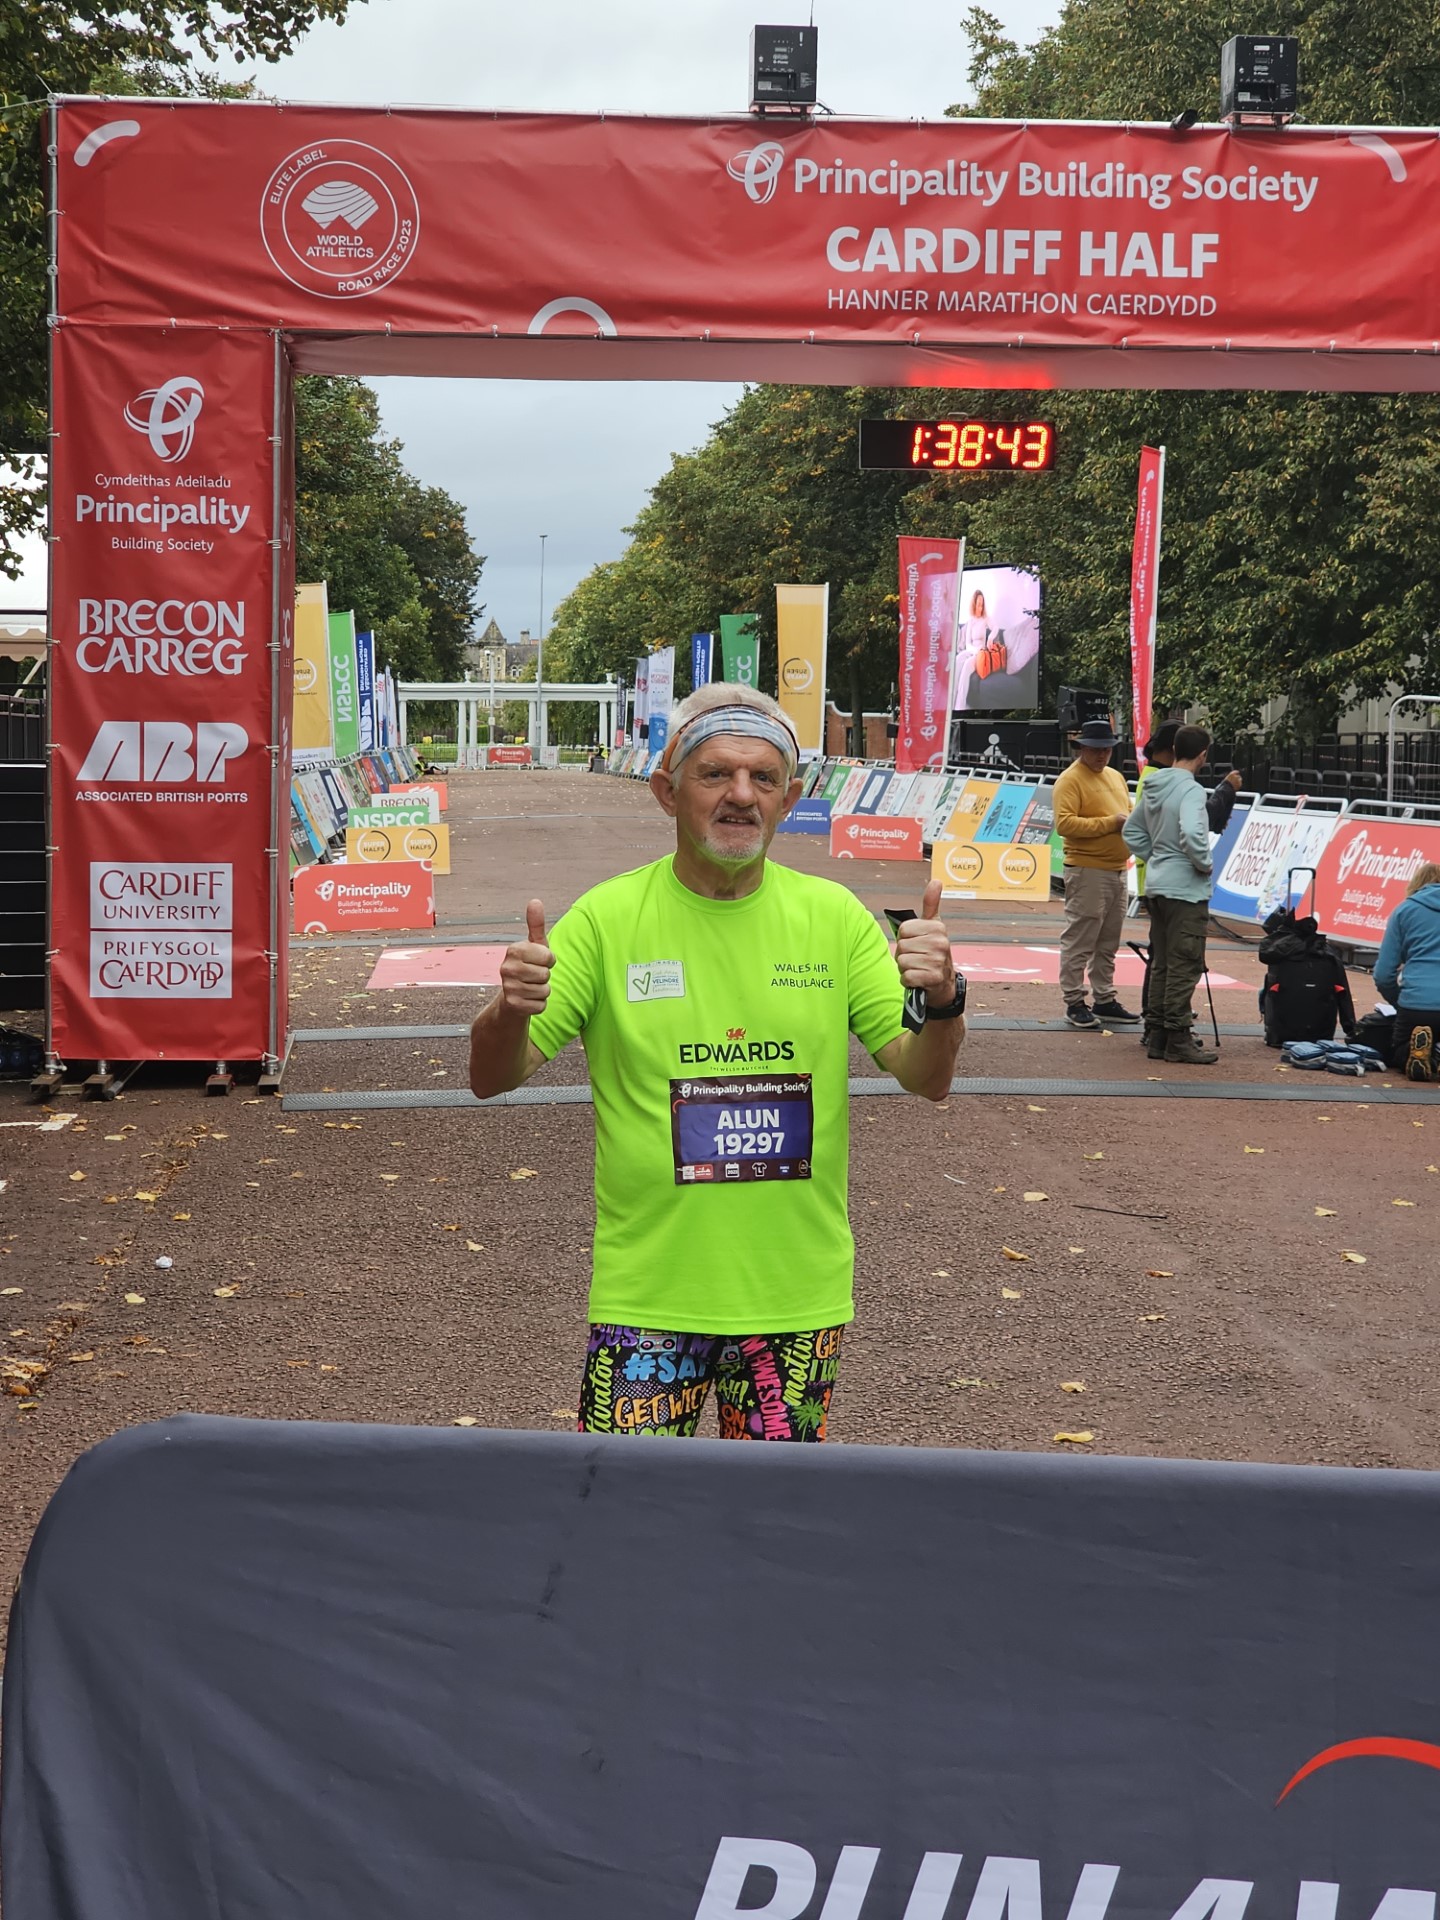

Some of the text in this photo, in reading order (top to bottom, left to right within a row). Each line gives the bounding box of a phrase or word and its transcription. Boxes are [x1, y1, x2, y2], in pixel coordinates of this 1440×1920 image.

[270, 149, 327, 204] ELITE LABEL
[794, 158, 1318, 212] Principality Building Society
[306, 246, 374, 258] ATHLETICS
[317, 235, 363, 246] WORLD
[826, 226, 1219, 278] CARDIFF HALF
[338, 219, 412, 291] ROAD RACE 2023
[828, 288, 1217, 317] HANNER MARATHON CAERDYDD
[911, 424, 1049, 468] 1:38:43
[95, 473, 231, 489] Cymdeithas Adeiladu
[76, 494, 250, 534] Principality
[111, 537, 214, 554] Building Society
[79, 599, 245, 637] BRECON
[75, 636, 249, 676] CARREG
[75, 721, 249, 782] ABP
[75, 791, 248, 803] ASSOCIATED BRITISH PORTS
[353, 811, 424, 829] NSPCC
[860, 828, 909, 841] Principality
[1239, 822, 1286, 858] BRECON
[1226, 853, 1270, 887] CARREG
[99, 869, 225, 900] CARDIFF
[337, 881, 411, 898] Principality
[103, 905, 220, 920] UNIVERSITY
[104, 941, 220, 955] PRIFYSGOL
[774, 963, 829, 974] WALES AIR
[770, 977, 835, 989] AMBULANCE
[679, 1041, 795, 1064] EDWARDS
[693, 1082, 809, 1096] Principality Building Society
[717, 1109, 780, 1130] ALUN
[713, 1132, 785, 1155] 19297
[751, 1351, 792, 1440] AWESOME
[615, 1393, 667, 1428] GET
[721, 1404, 746, 1430] ON
